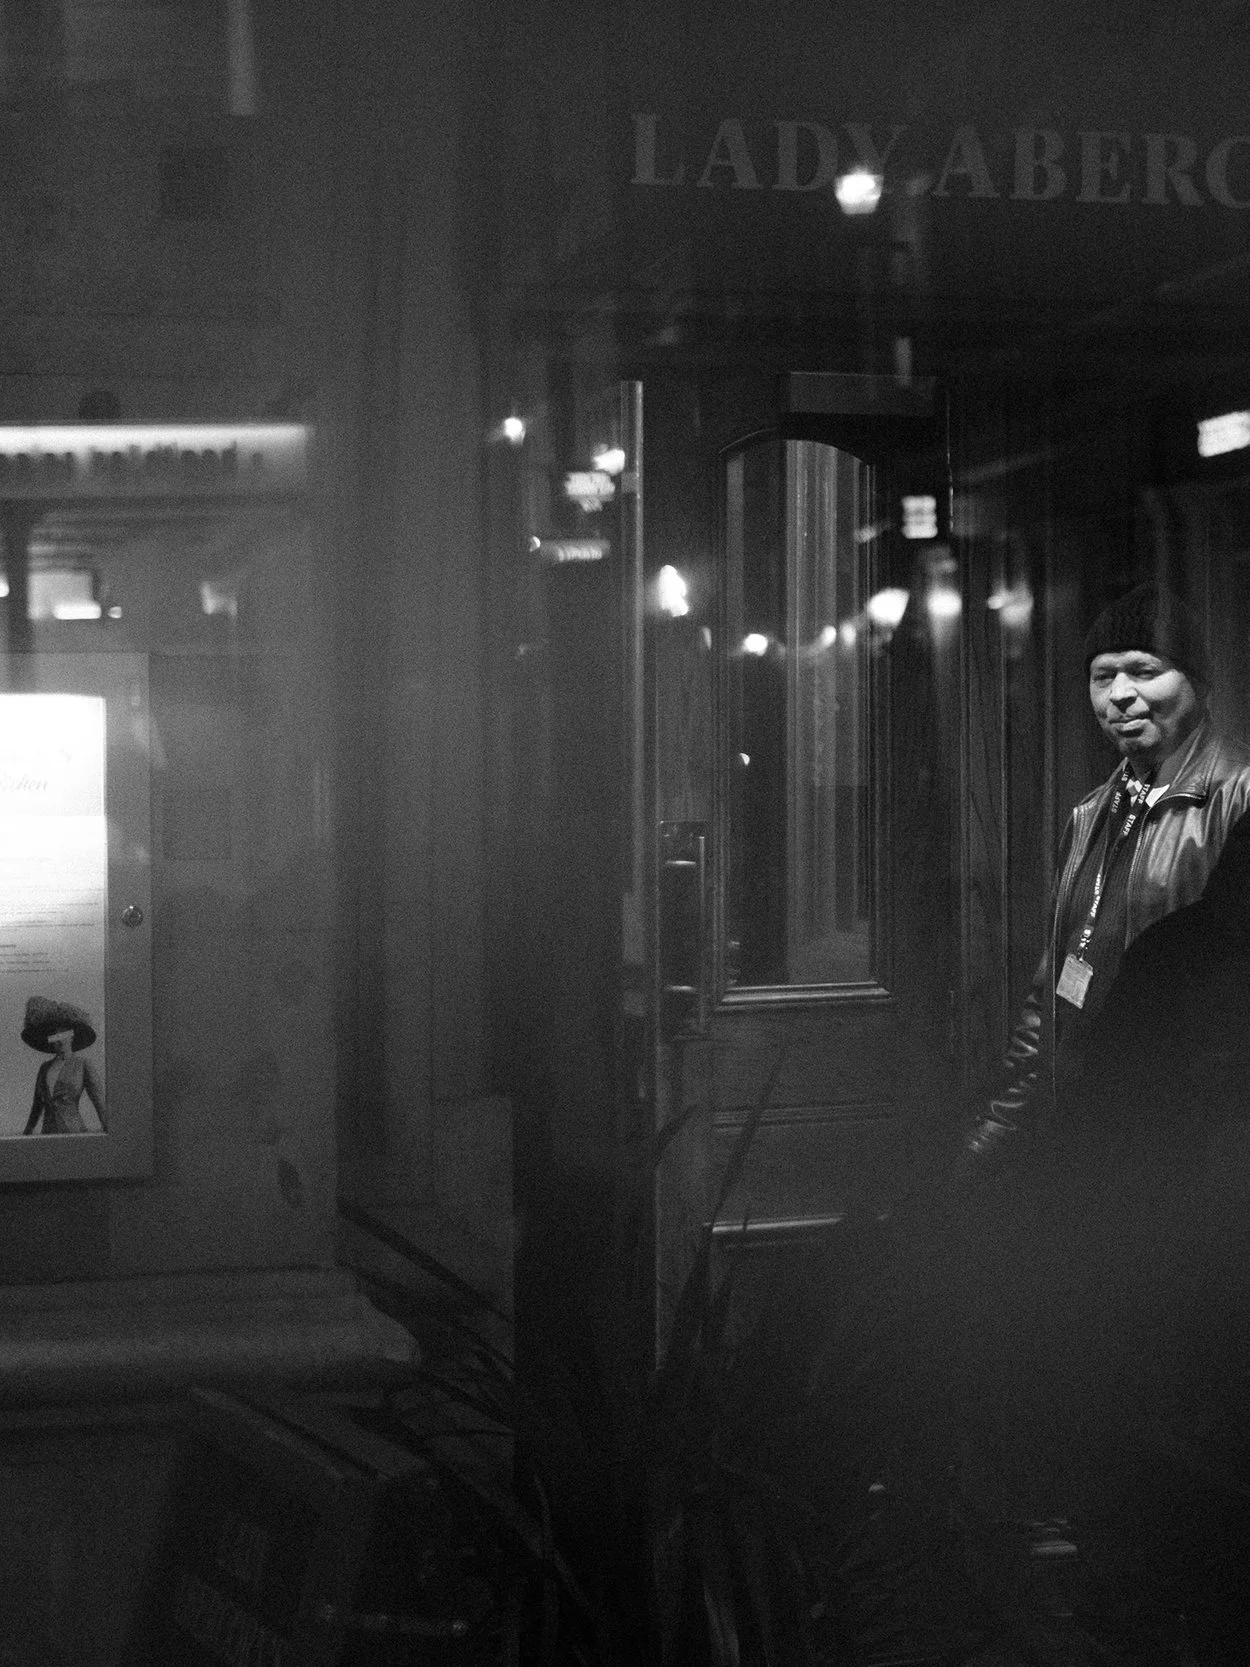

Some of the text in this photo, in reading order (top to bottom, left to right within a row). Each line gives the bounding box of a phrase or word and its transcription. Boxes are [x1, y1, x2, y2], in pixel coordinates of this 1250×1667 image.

[630, 113, 907, 194] LADY
[1111, 791, 1122, 813] STAFF
[1122, 813, 1136, 836] STAFF
